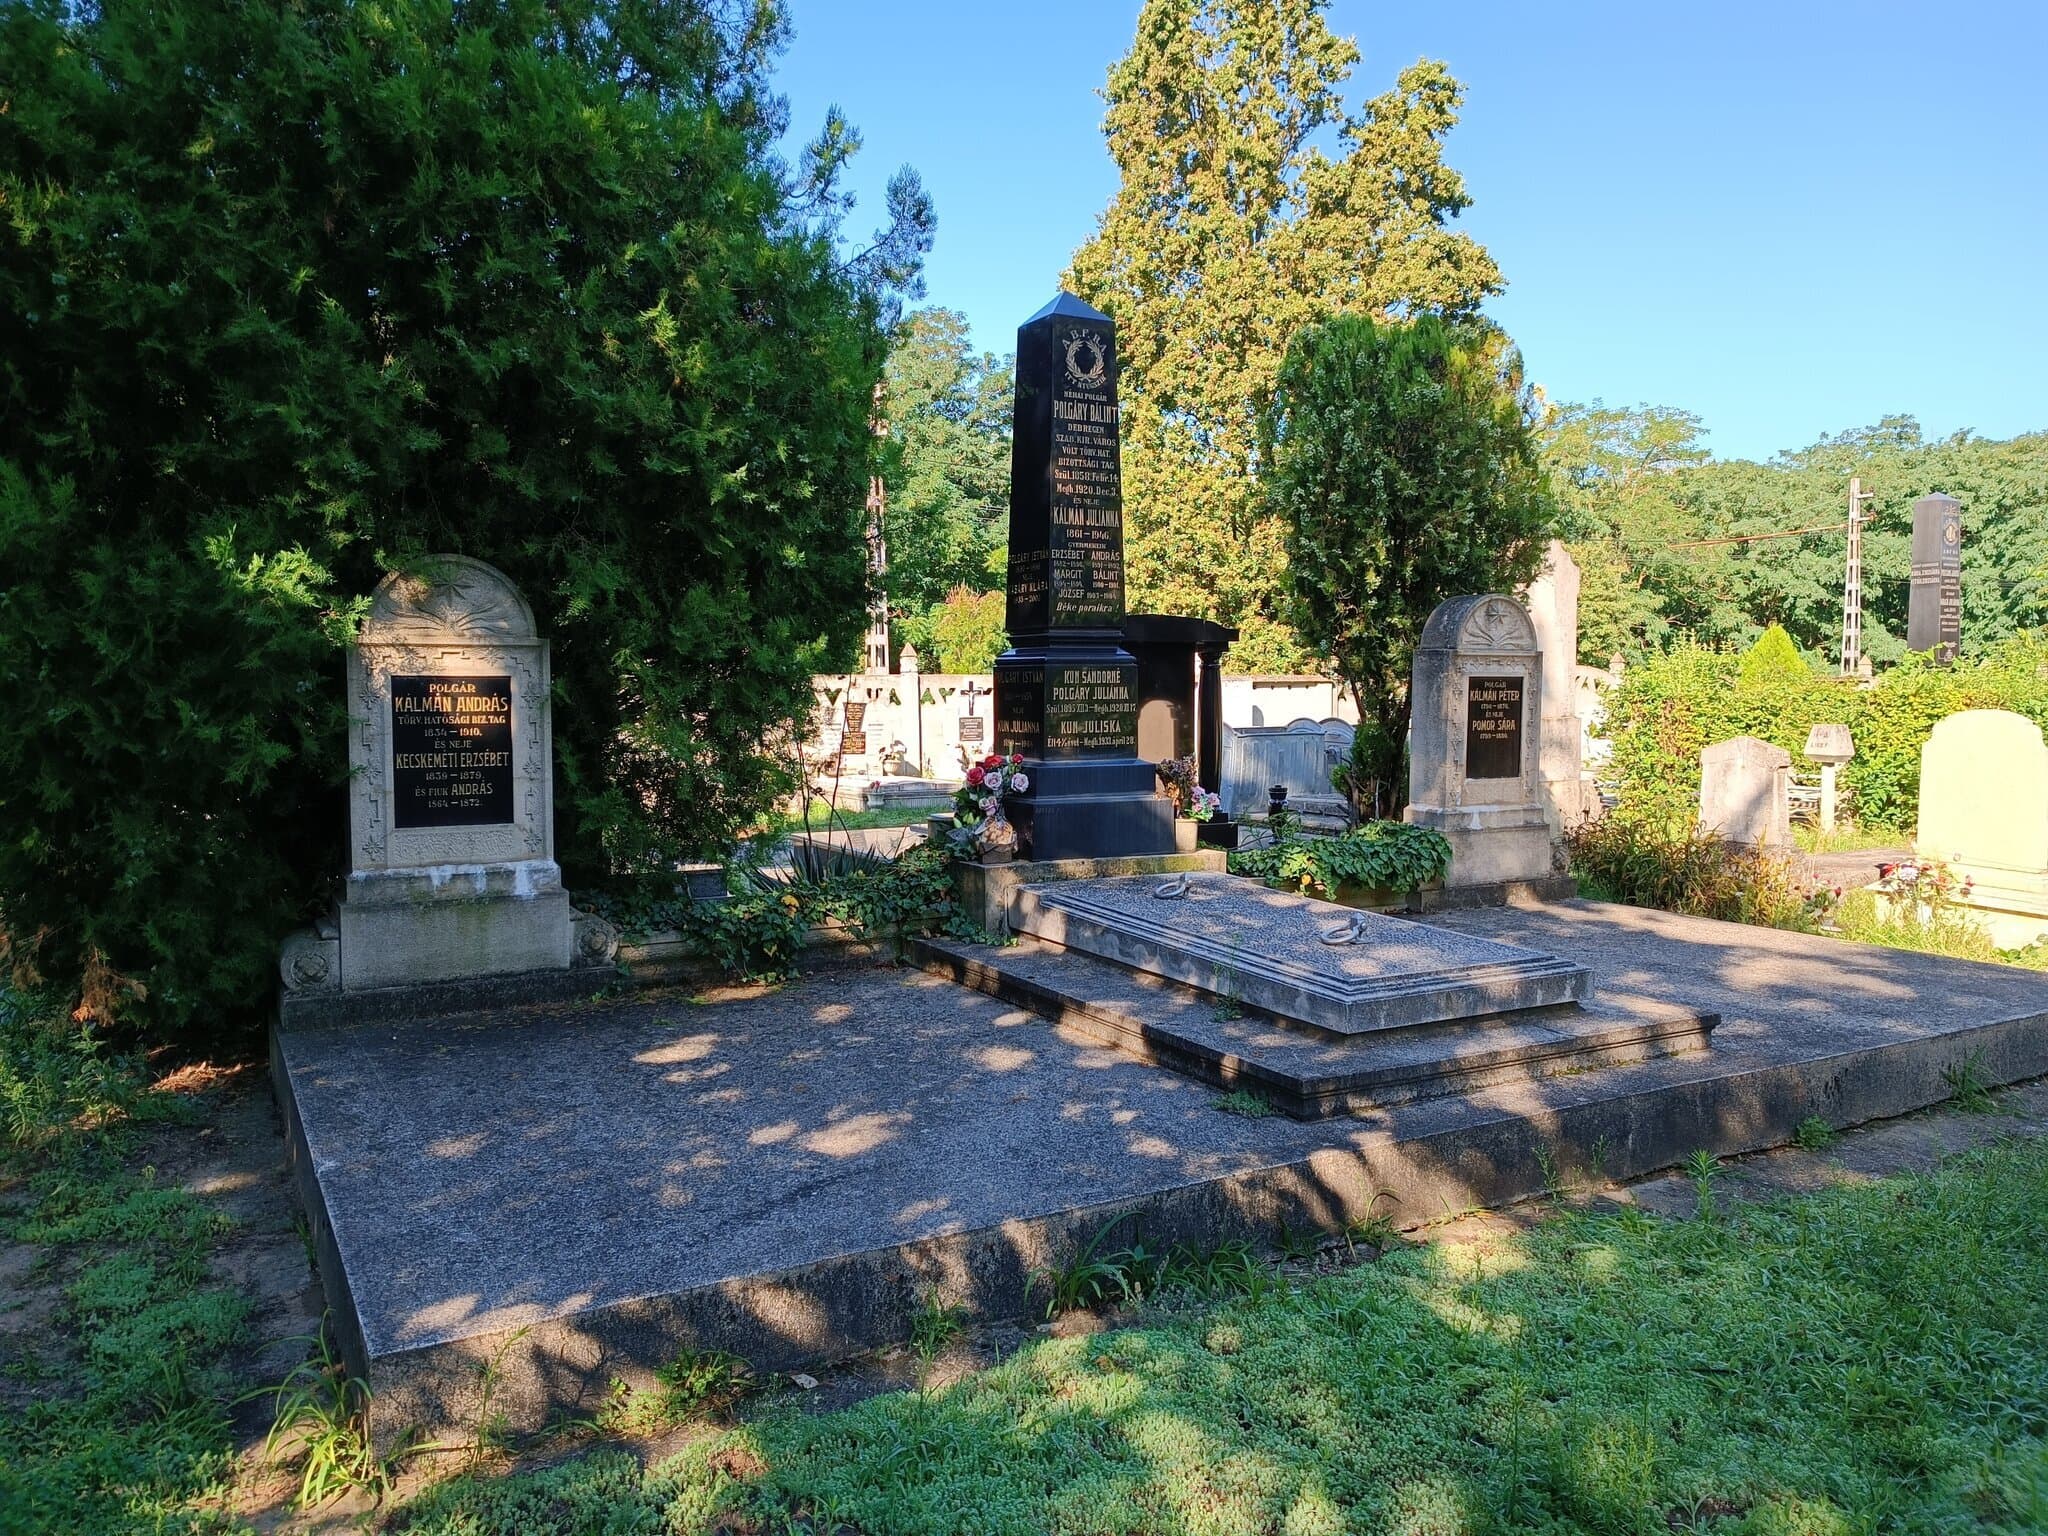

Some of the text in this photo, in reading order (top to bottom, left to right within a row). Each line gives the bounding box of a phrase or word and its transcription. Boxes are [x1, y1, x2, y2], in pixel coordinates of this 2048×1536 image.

[1084, 392, 1107, 401] POLGÁR
[1054, 400, 1118, 424] POLGÁRY BÁLINT
[1068, 423, 1105, 434] DEBRECEN
[1058, 457, 1115, 469] BIZOTTSÁGI TAG
[1073, 495, 1082, 504] ÉS
[1053, 504, 1120, 527] KÁLMÁN JULIÁNNA
[1051, 547, 1120, 561] ERZSÉBET ANDRÁS
[1054, 569, 1119, 580] MARGIT BÁLINT
[1056, 602, 1077, 612] Béke
[1064, 667, 1121, 683] KUN SÁNDORNÉ
[429, 681, 477, 693] POLGÁR
[1484, 680, 1507, 688] POLGÁR
[1053, 685, 1129, 700] POLGÁRY JULIÁNNA
[1470, 688, 1520, 702] KÁLMÁN PÉTER
[395, 693, 508, 712] KÁLMÁN ANDRÁS
[424, 713, 470, 724] HATÓSÁGI
[1472, 717, 1516, 731] POMOR SÁRA
[1060, 720, 1121, 734] KUN JULISKA
[434, 738, 472, 749] ÉS NEJE
[396, 748, 509, 769] KECSKEMÉTI ERZSÉBET
[415, 780, 493, 797] ÉS FIUK ANDRÁS
